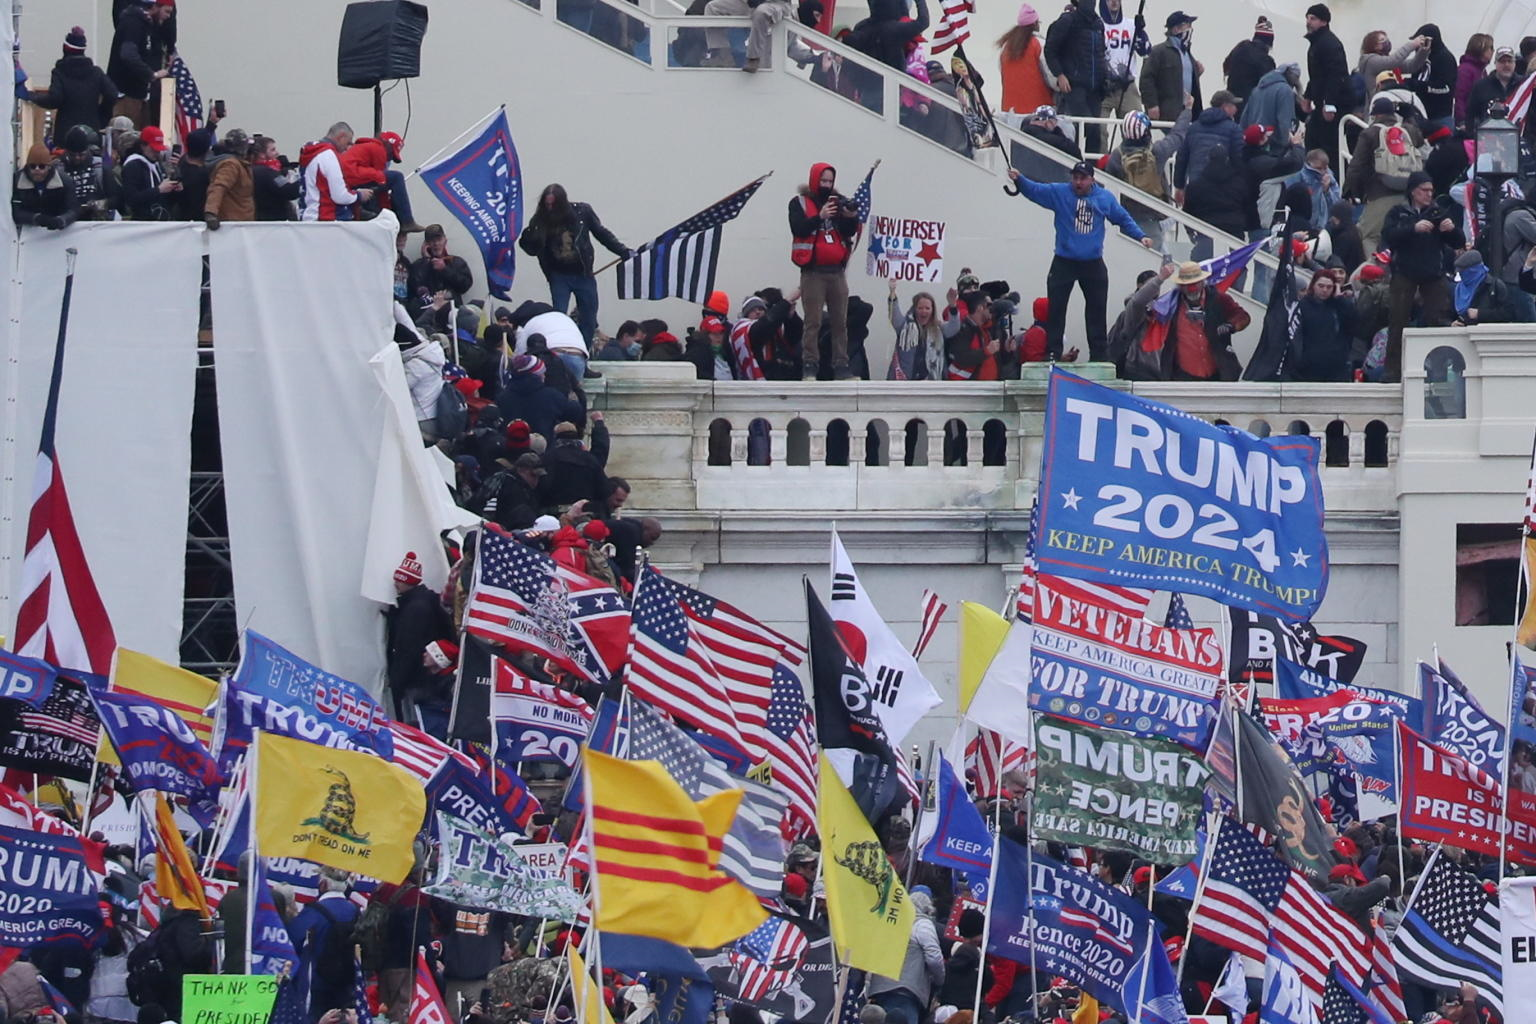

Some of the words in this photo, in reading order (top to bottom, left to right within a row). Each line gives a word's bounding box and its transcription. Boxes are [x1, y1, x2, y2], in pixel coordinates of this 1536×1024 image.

[448, 178, 480, 211] KEEPING
[875, 216, 897, 236] NEW
[896, 219, 946, 241] JERSEY
[886, 237, 912, 249] FOR
[876, 260, 890, 278] NO
[895, 262, 925, 282] JOE
[1066, 397, 1306, 517] TRUMP
[1093, 484, 1280, 573] 2024
[1048, 529, 1115, 557] KEEP
[1119, 543, 1225, 576] AMERICA
[1231, 563, 1318, 607] TRUMP!
[1036, 581, 1222, 667] VETERANS
[1033, 629, 1078, 654] KEEP
[1081, 646, 1155, 677] AMERICA
[1160, 668, 1216, 693] GREAT!
[1031, 656, 1089, 699] FOR
[1097, 675, 1204, 728] TRUMP
[1300, 669, 1325, 689] ALL
[533, 705, 549, 718] NO
[24, 749, 48, 762] MY
[1441, 720, 1486, 766] 2020
[1467, 787, 1485, 804] IS
[1490, 797, 1503, 810] M
[341, 843, 355, 855] ON
[357, 848, 372, 859] ME
[521, 852, 557, 867] AREA
[946, 837, 982, 854] KEEP
[1031, 861, 1135, 943] Trump
[1018, 915, 1083, 953] Pence
[1081, 938, 1126, 977] 2020
[1007, 934, 1057, 960] KEEPING
[1086, 966, 1124, 992] GREAT!
[191, 980, 249, 996] THANK
